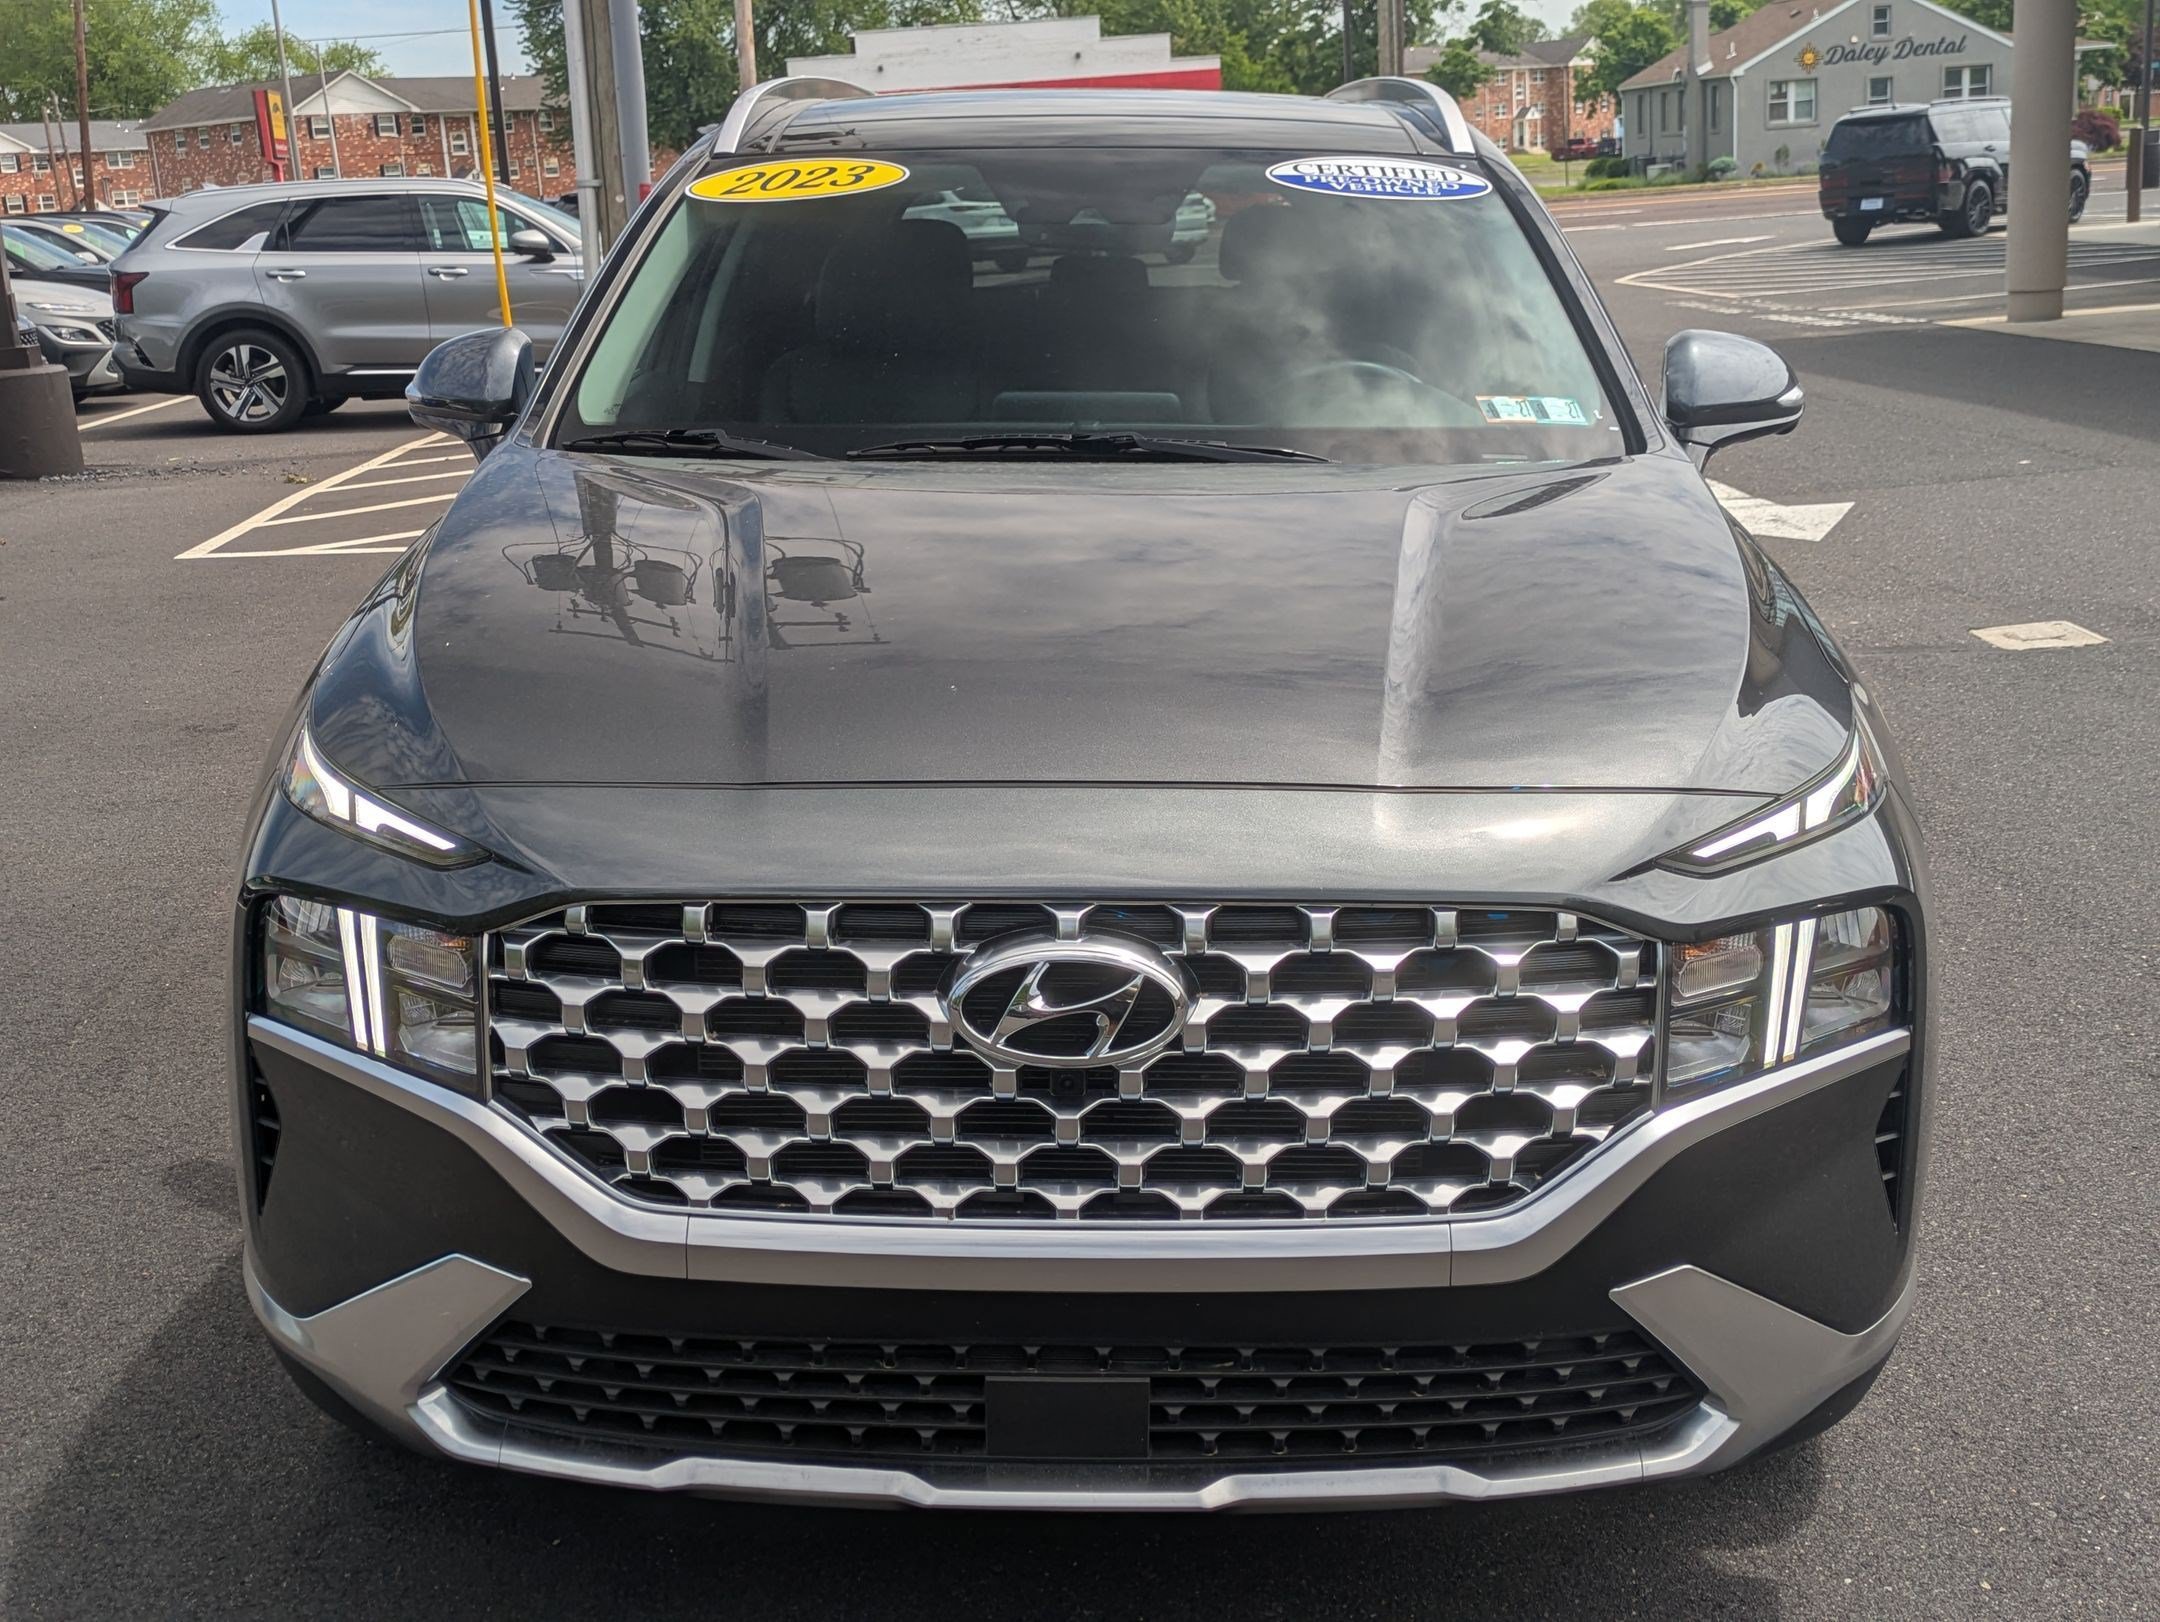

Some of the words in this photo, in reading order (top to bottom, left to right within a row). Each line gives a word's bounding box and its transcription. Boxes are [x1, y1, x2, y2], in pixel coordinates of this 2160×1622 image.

[1823, 43, 1889, 66] Daley
[1892, 35, 1967, 60] Dental
[719, 165, 875, 196] 2023
[1293, 163, 1463, 183] CERTIFIED
[1304, 174, 1460, 191] PRE-OWNED
[1328, 181, 1441, 196] VEHICLE
